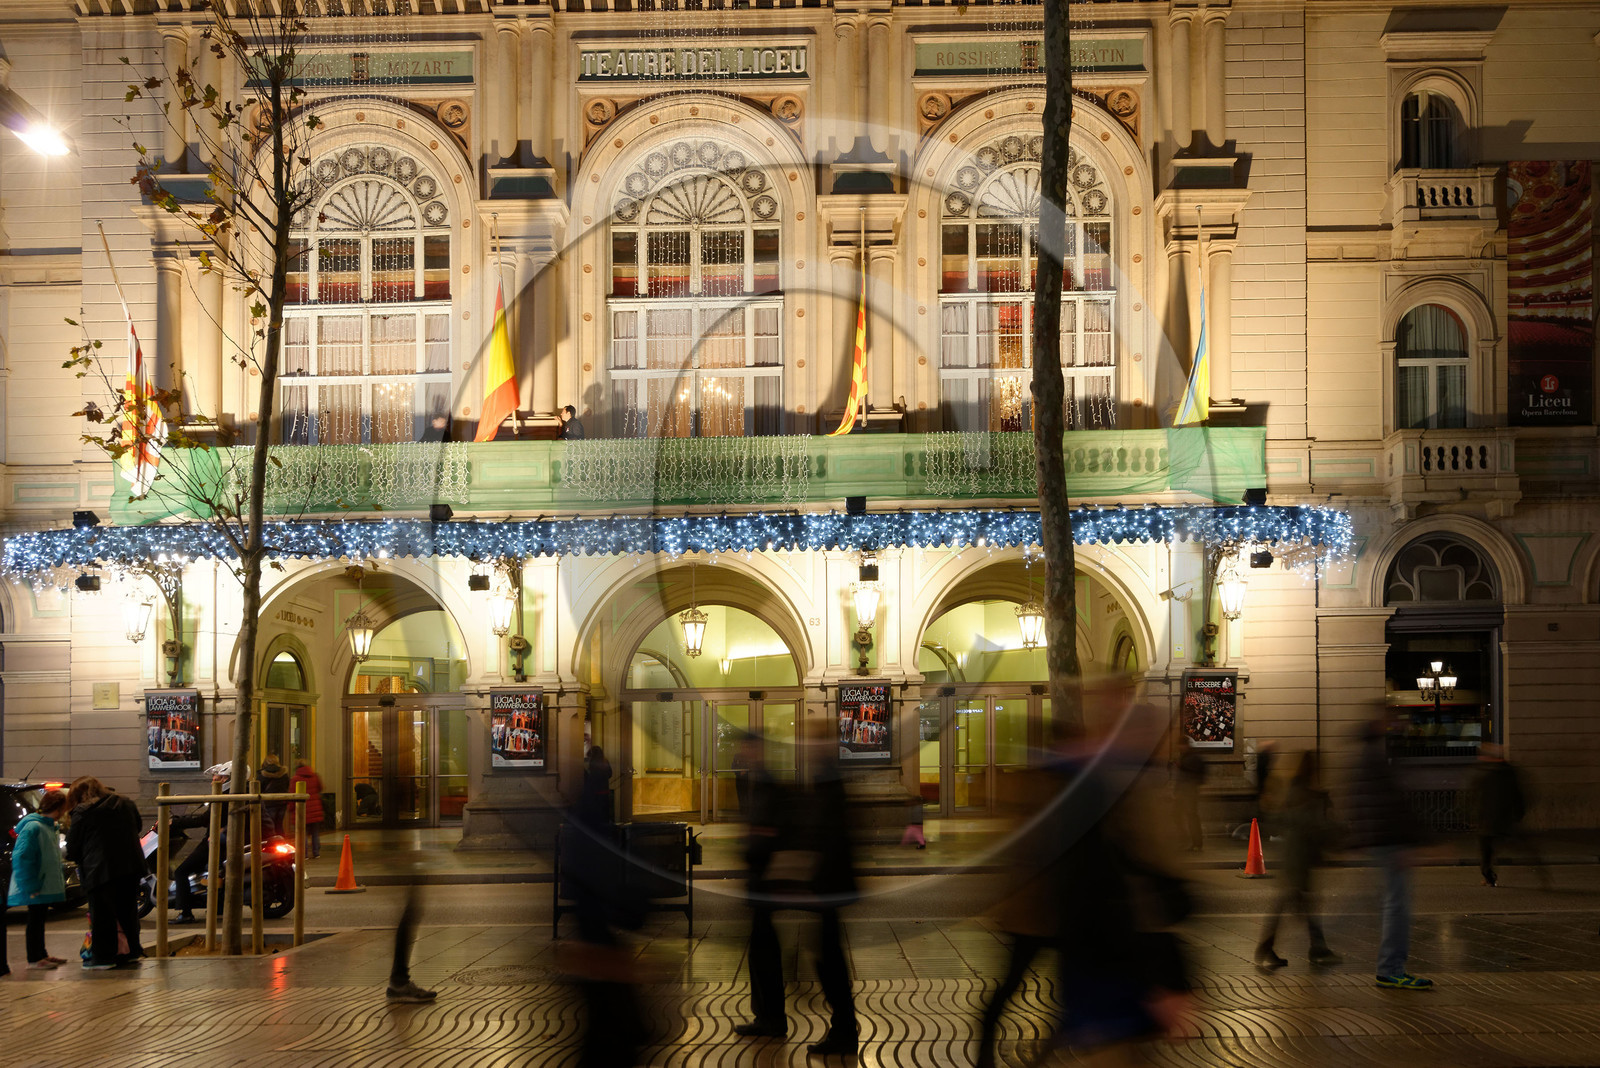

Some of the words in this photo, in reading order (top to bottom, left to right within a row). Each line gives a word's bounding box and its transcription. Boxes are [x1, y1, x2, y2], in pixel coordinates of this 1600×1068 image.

[387, 60, 454, 76] MOZART
[581, 50, 676, 76] TEATRE
[681, 50, 730, 76] DEL
[736, 49, 806, 75] LICEU
[1528, 394, 1571, 408] Liceu
[809, 617, 821, 626] 63
